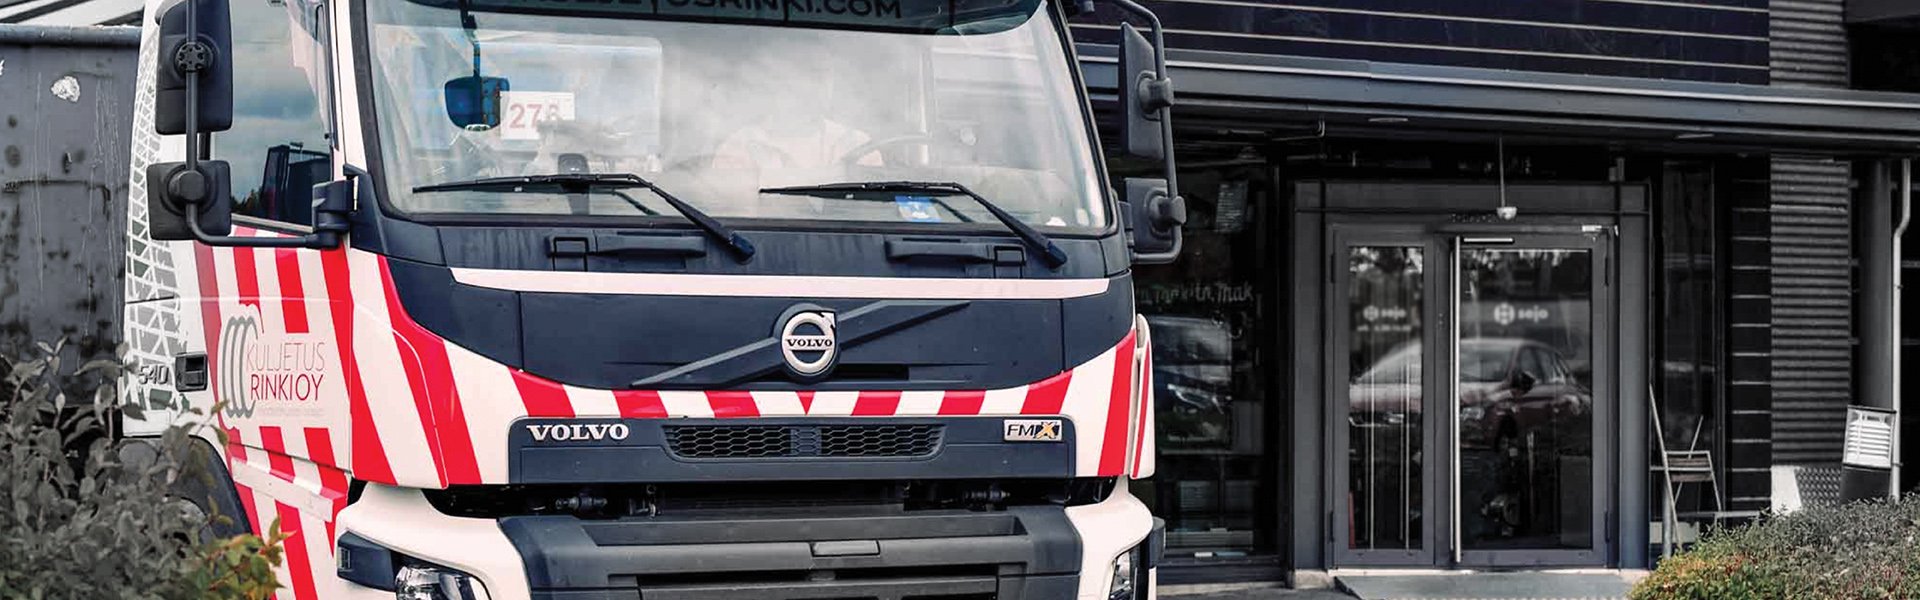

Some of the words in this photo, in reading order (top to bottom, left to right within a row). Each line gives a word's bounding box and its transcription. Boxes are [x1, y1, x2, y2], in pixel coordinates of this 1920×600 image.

[786, 338, 833, 347] VOLVO
[247, 341, 326, 372] KULJETUS
[139, 364, 170, 385] 540
[525, 423, 630, 441] VOLVO
[1006, 421, 1061, 439] FMX
